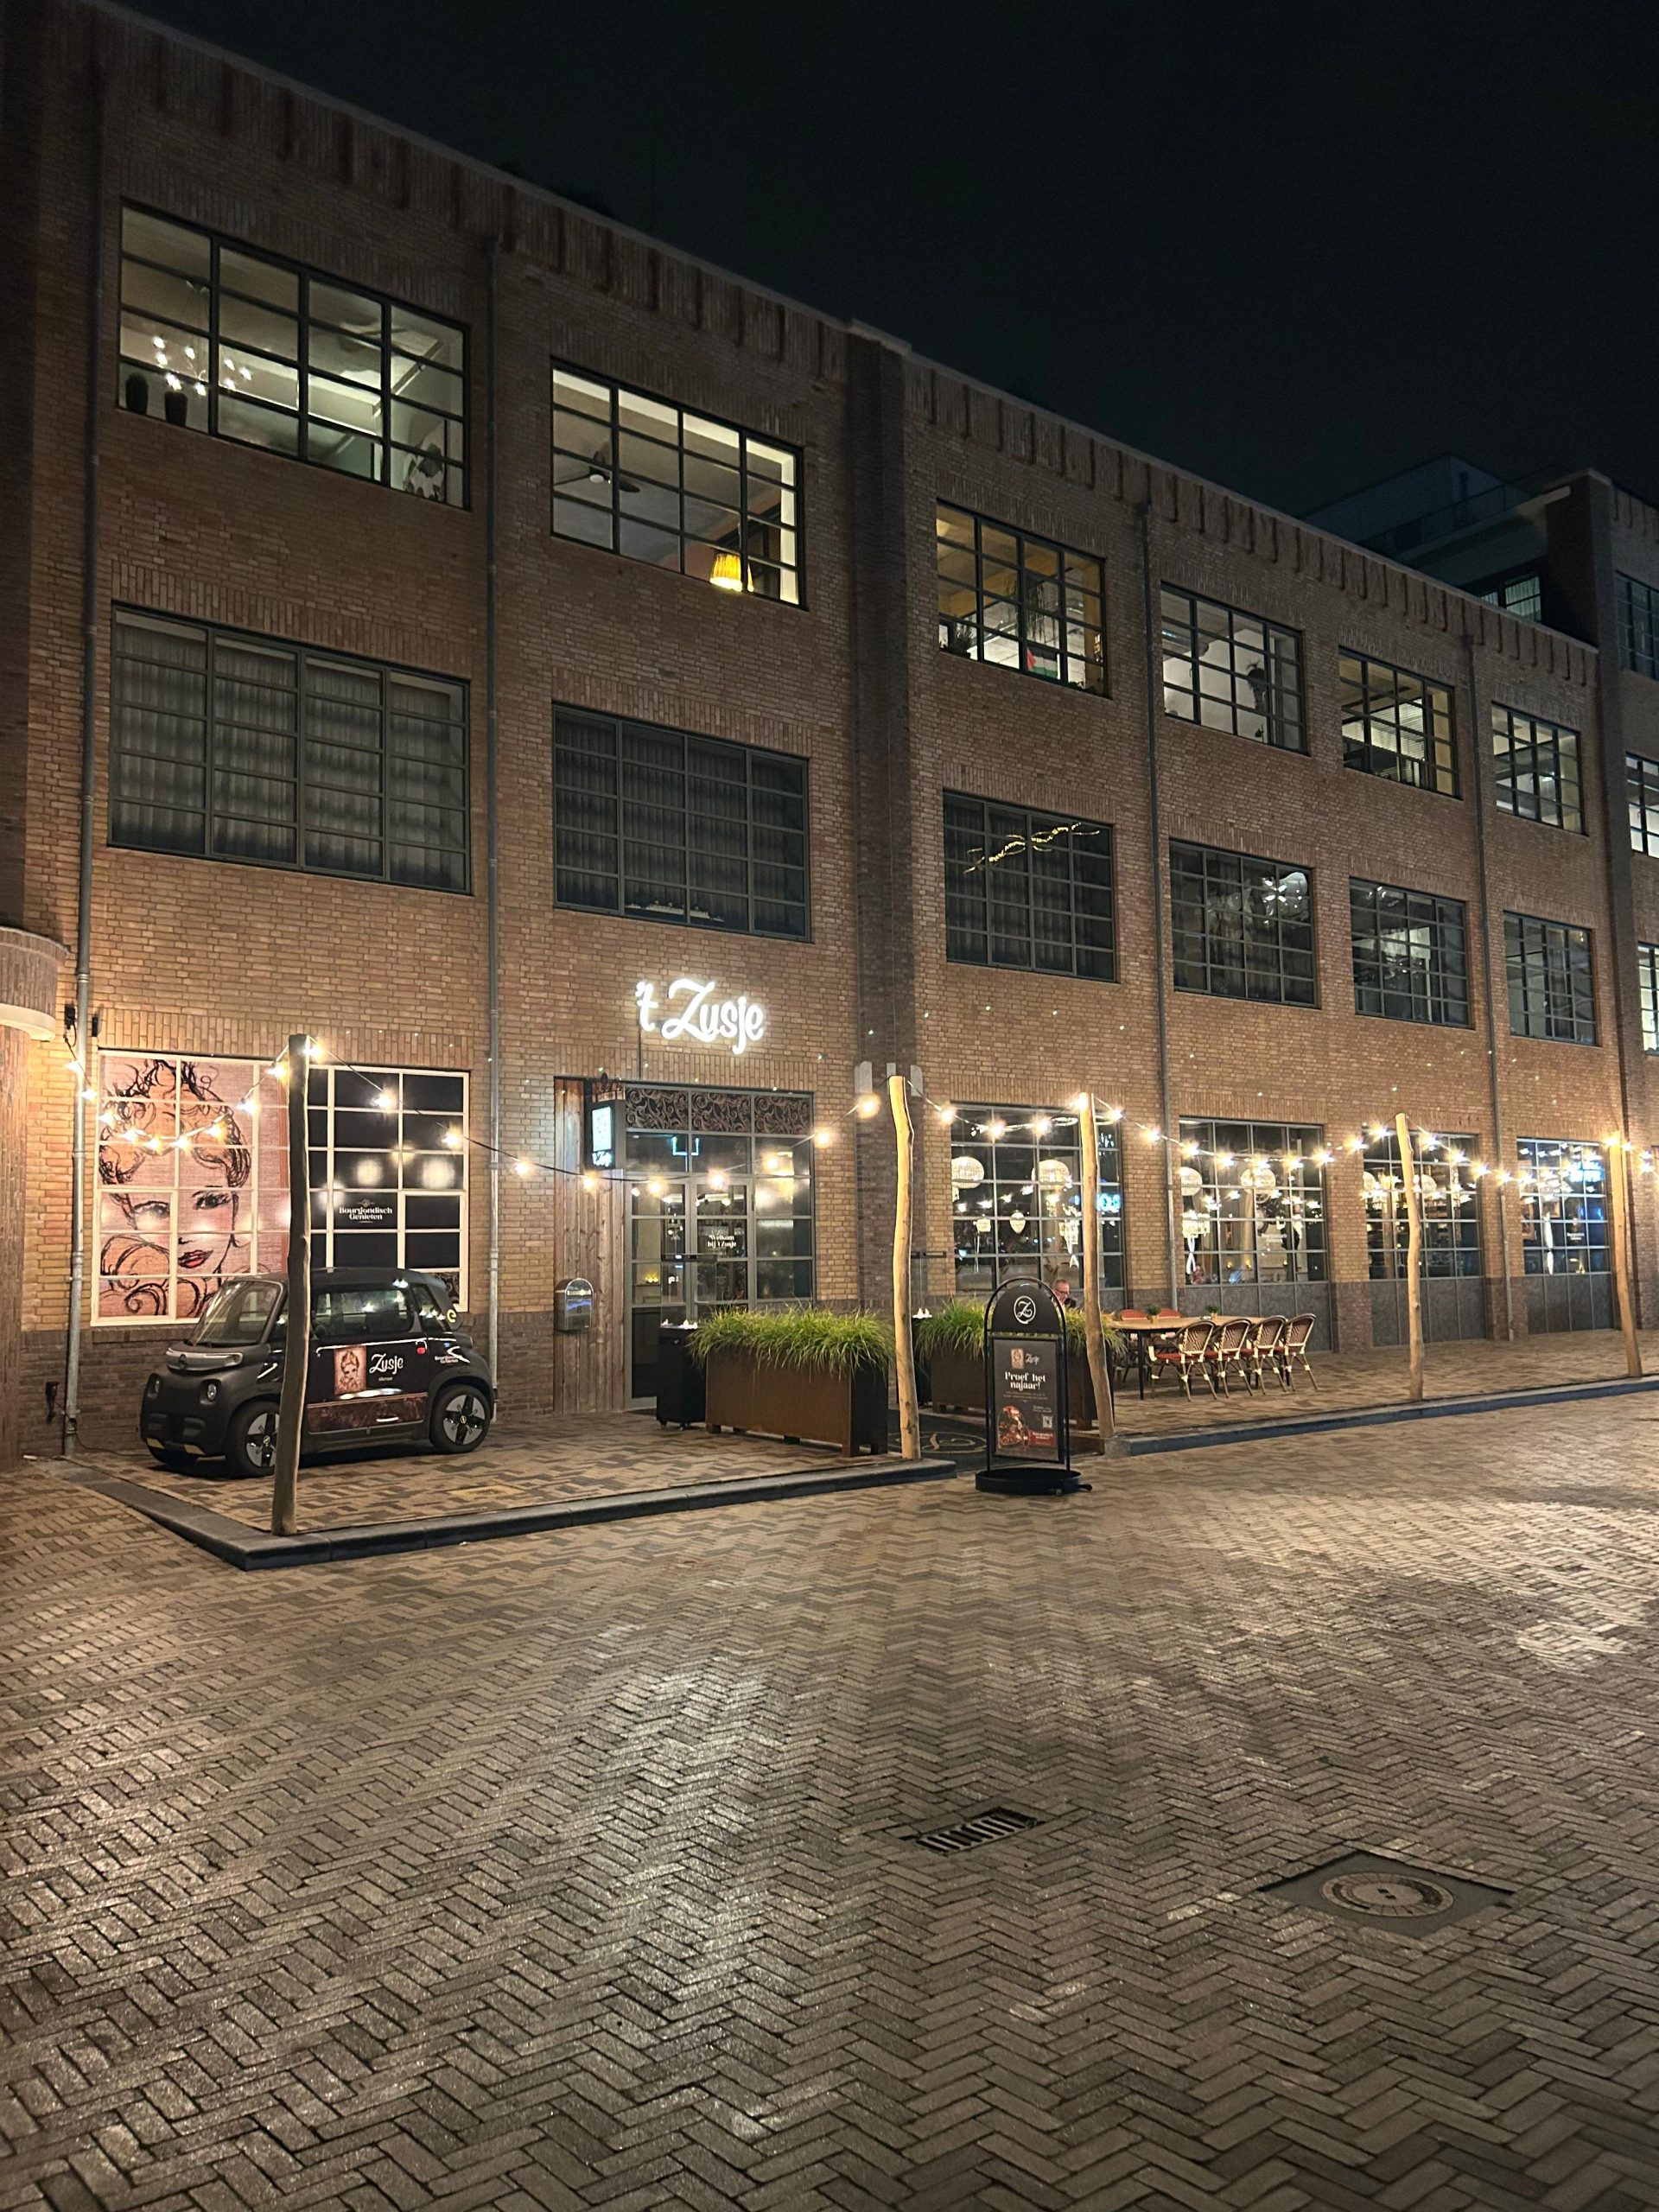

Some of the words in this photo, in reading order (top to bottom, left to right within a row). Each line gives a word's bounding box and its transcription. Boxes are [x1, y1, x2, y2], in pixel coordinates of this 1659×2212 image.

[661, 978, 764, 1055] Zusje
[339, 1206, 393, 1215] Bourgondisch
[369, 1353, 404, 1375] Zusje
[1004, 1371, 1030, 1382] Proef
[1032, 1373, 1046, 1382] het
[1010, 1381, 1041, 1391] najaar!
